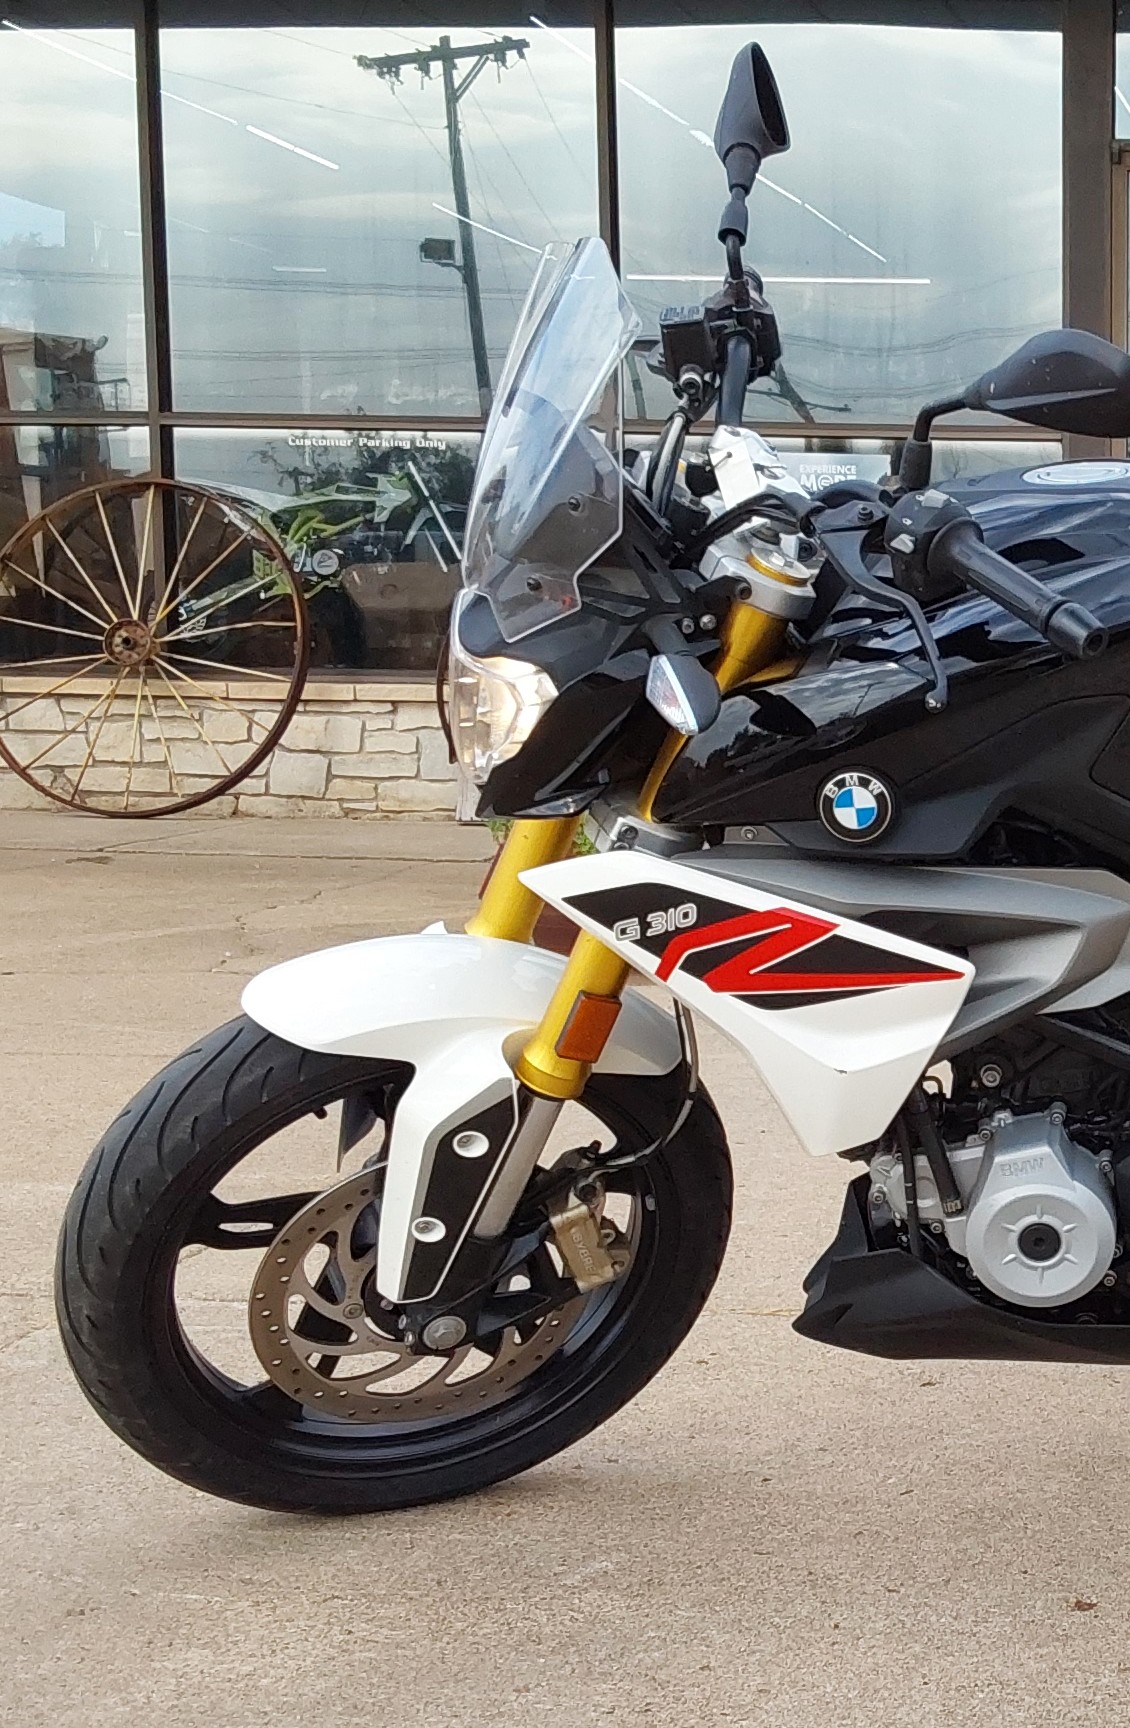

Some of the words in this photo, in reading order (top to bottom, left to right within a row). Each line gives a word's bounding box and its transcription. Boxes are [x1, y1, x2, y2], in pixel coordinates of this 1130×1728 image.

[288, 436, 353, 447] Customer
[359, 437, 411, 449] Parking
[415, 438, 447, 451] Only
[801, 464, 857, 474] EXPERIENCE
[825, 775, 883, 799] BMW
[613, 917, 641, 943] G
[645, 903, 698, 937] 310
[1000, 1158, 1044, 1177] BMW
